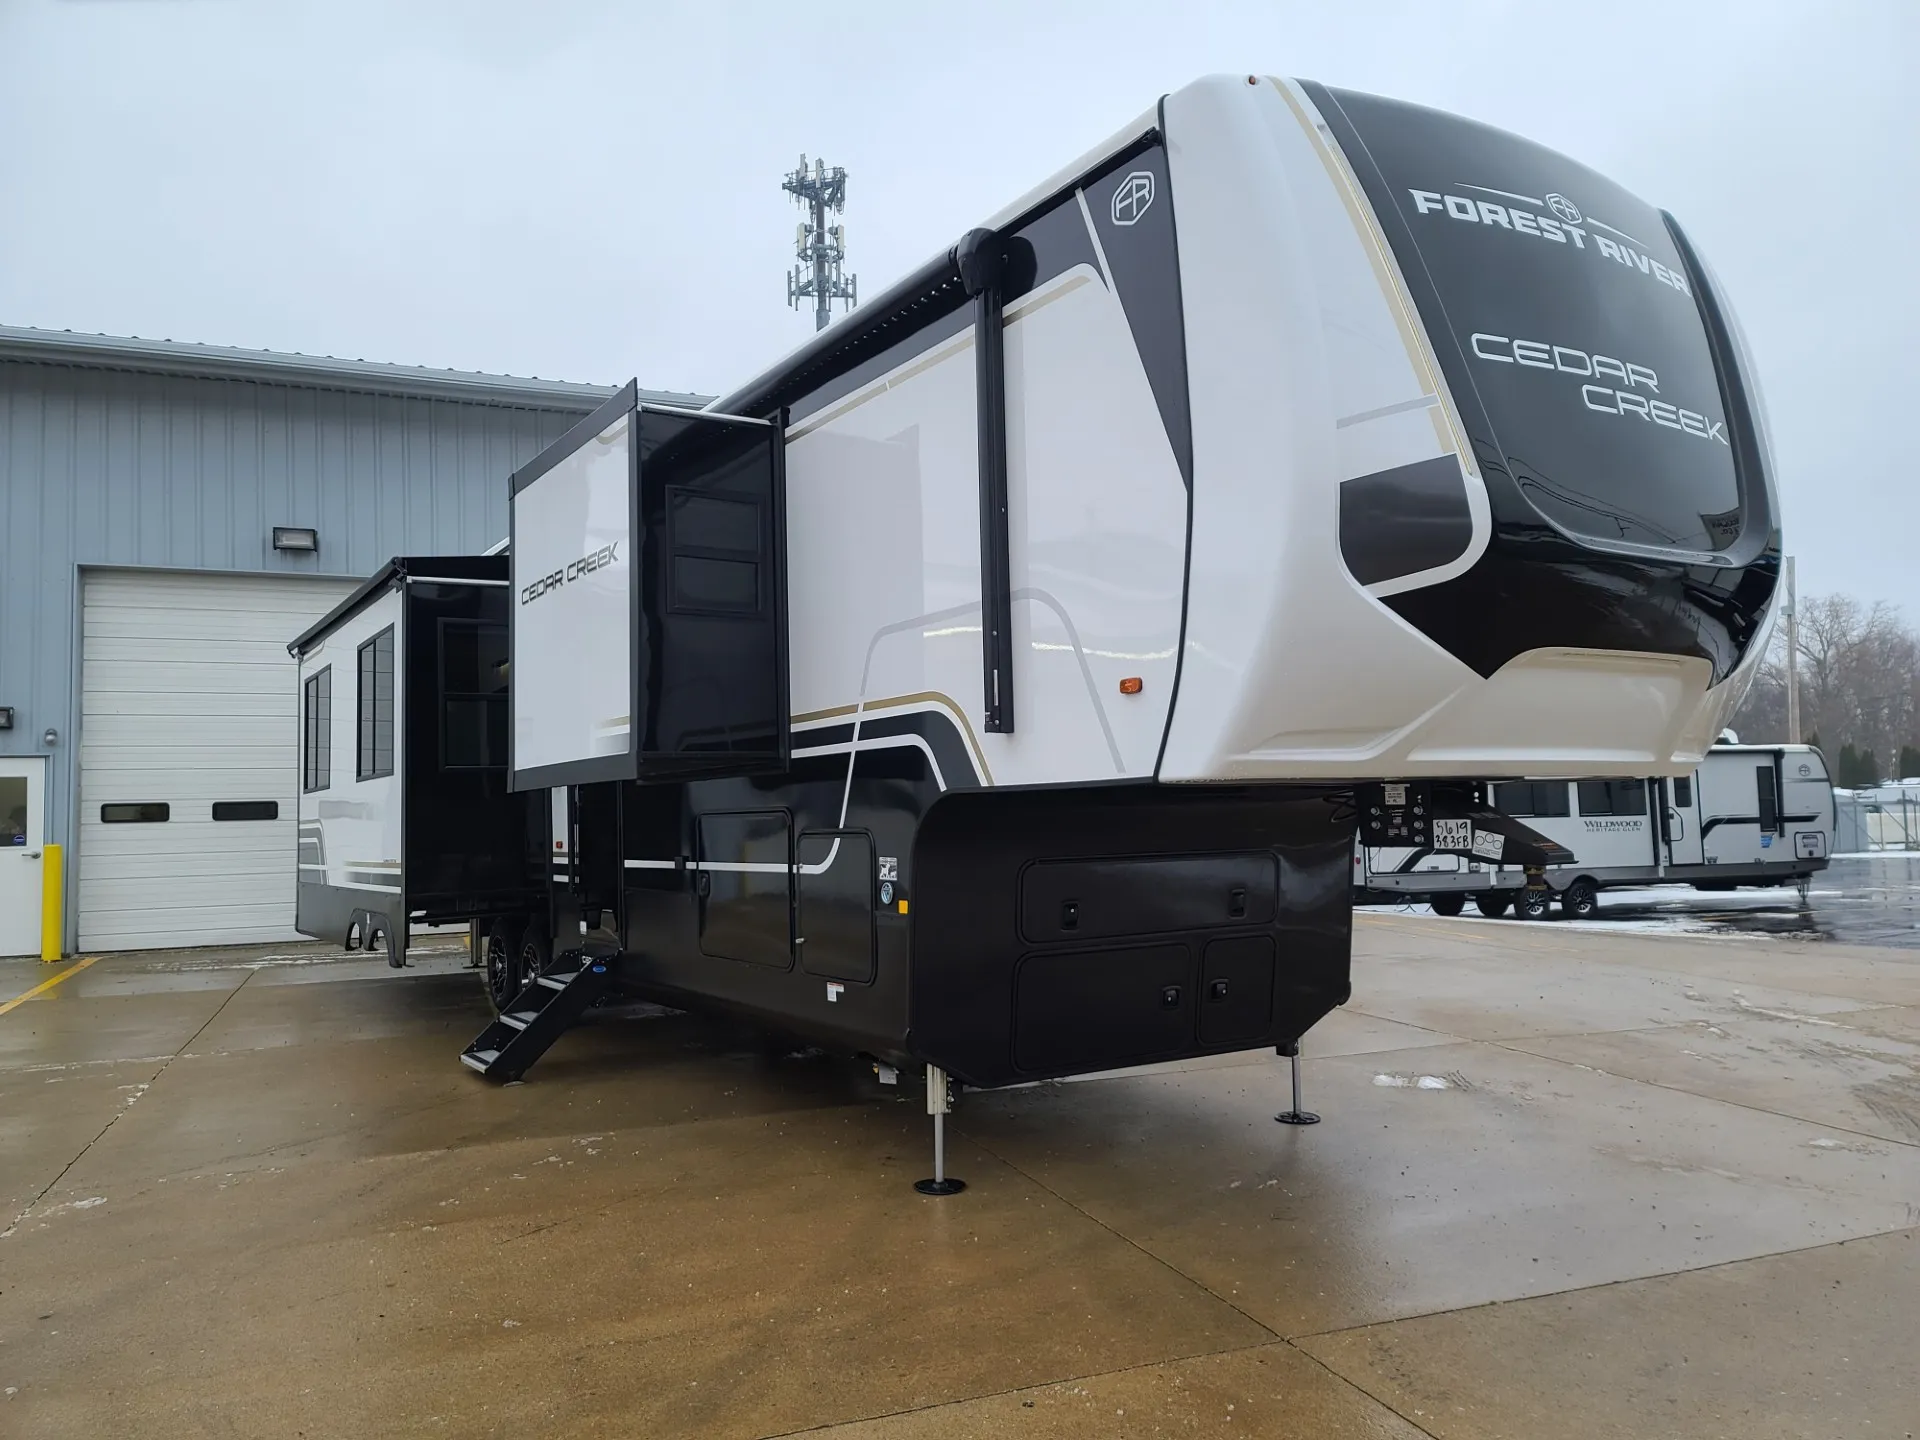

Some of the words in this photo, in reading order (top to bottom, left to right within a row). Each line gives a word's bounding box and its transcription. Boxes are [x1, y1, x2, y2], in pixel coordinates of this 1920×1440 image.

[1408, 188, 1586, 249] FOREST
[1592, 233, 1693, 298] RIVER
[1471, 332, 1660, 394] CEDAR
[1582, 384, 1729, 446] CREEK
[521, 568, 564, 606] CEDAR
[566, 540, 619, 582] CREEK
[1435, 834, 1469, 848] 383FB
[1436, 821, 1468, 835] 5619
[1583, 820, 1643, 828] WILDWOOD
